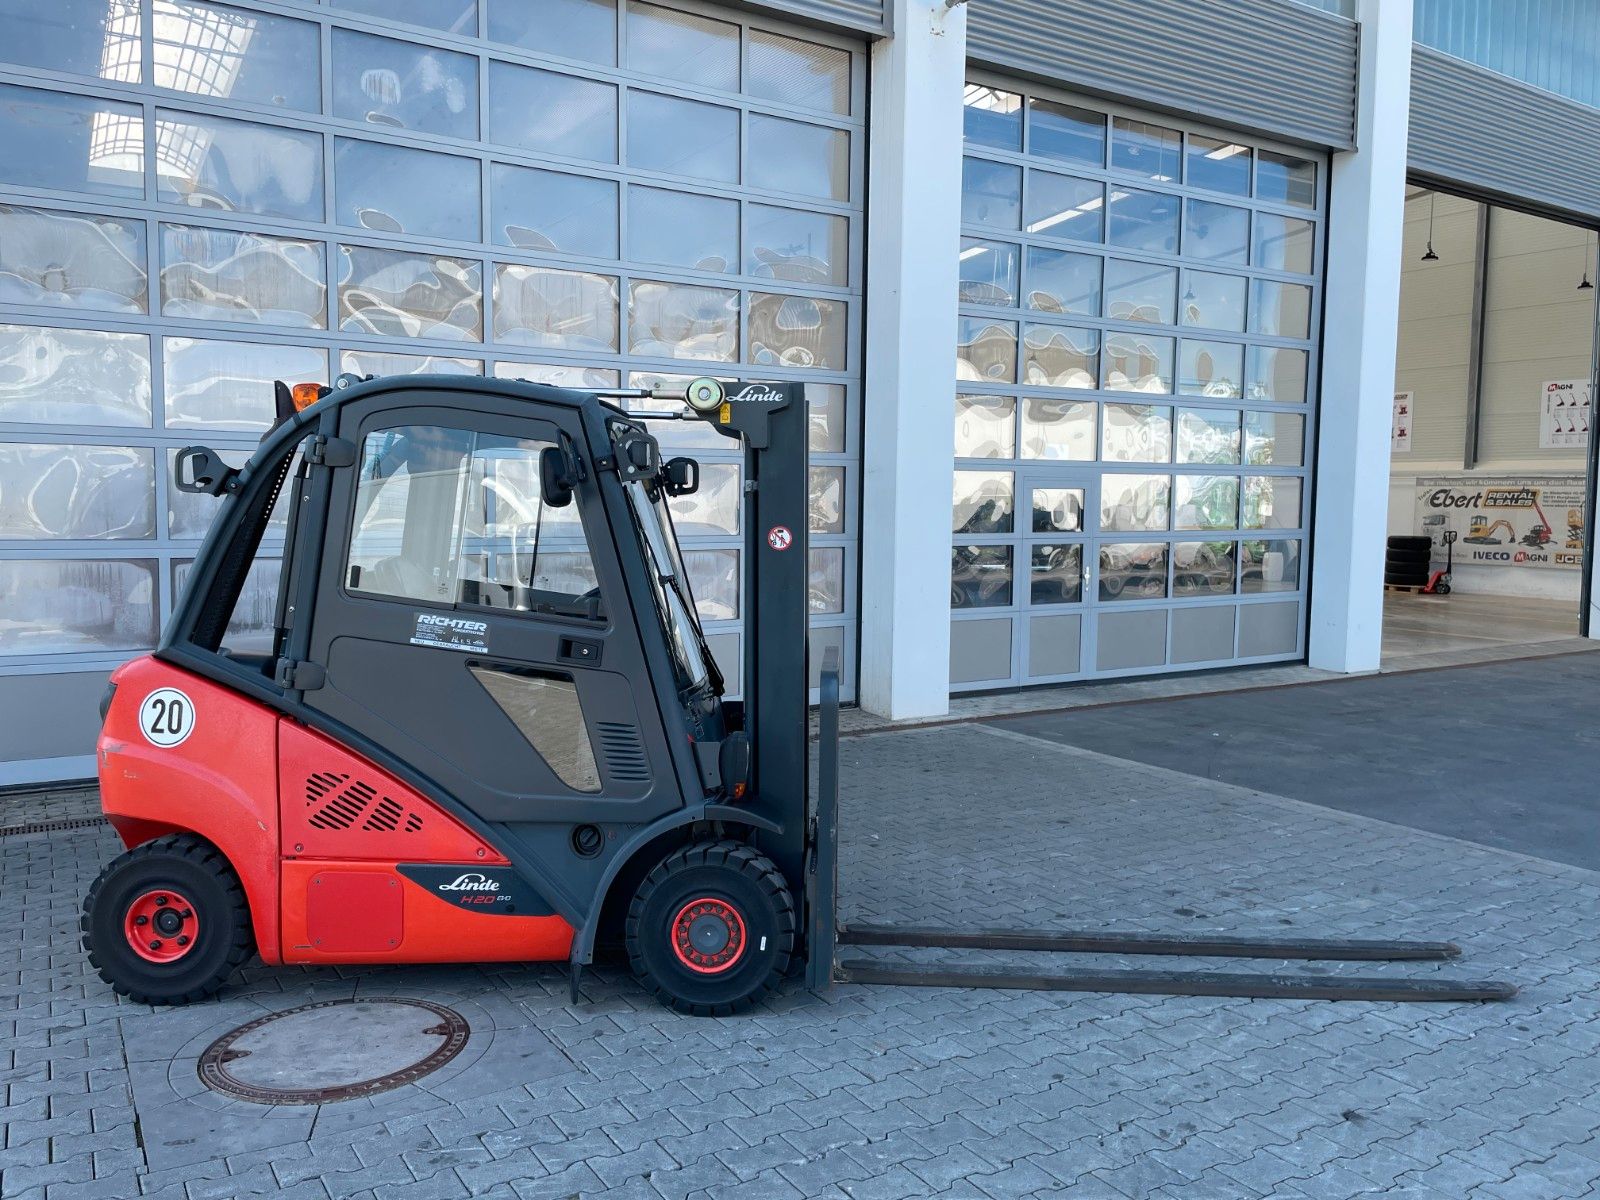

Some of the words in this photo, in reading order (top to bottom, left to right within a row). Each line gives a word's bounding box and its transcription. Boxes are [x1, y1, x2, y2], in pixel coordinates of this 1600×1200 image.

[725, 384, 784, 402] Linde
[1430, 488, 1483, 508] Ebert
[1473, 551, 1510, 560] IVECO
[1514, 551, 1548, 563] MAGNI
[150, 698, 184, 735] 20
[438, 873, 500, 891] Linde
